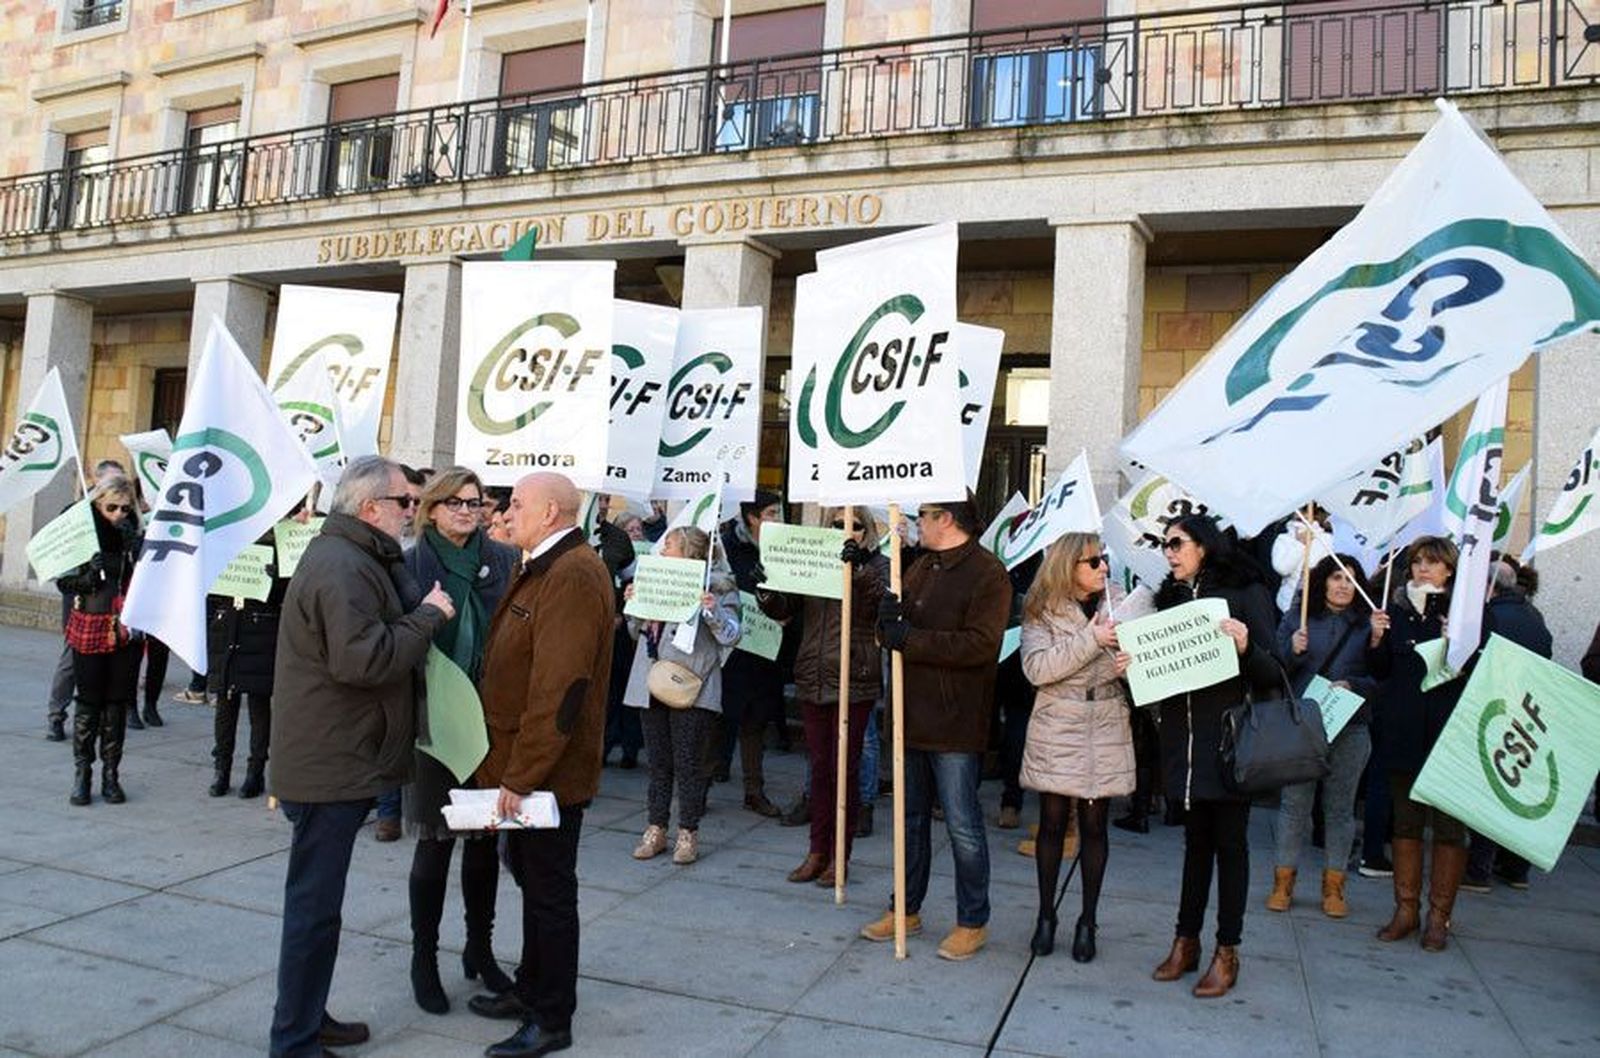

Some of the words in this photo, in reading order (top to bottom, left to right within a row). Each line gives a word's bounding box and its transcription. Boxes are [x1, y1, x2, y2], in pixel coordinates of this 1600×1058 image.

[317, 214, 567, 262] SUBDELEGACION
[587, 207, 654, 241] DEL
[668, 193, 883, 236] GOBIERNO
[485, 448, 576, 467] Zamora
[847, 461, 933, 481] Zamora
[1136, 619, 1193, 646] EXIGIMOS
[1194, 612, 1211, 627] UN
[1135, 644, 1177, 664] TRATO
[1178, 631, 1212, 654] JUSTO
[1145, 647, 1221, 680] IGUALITARIO
